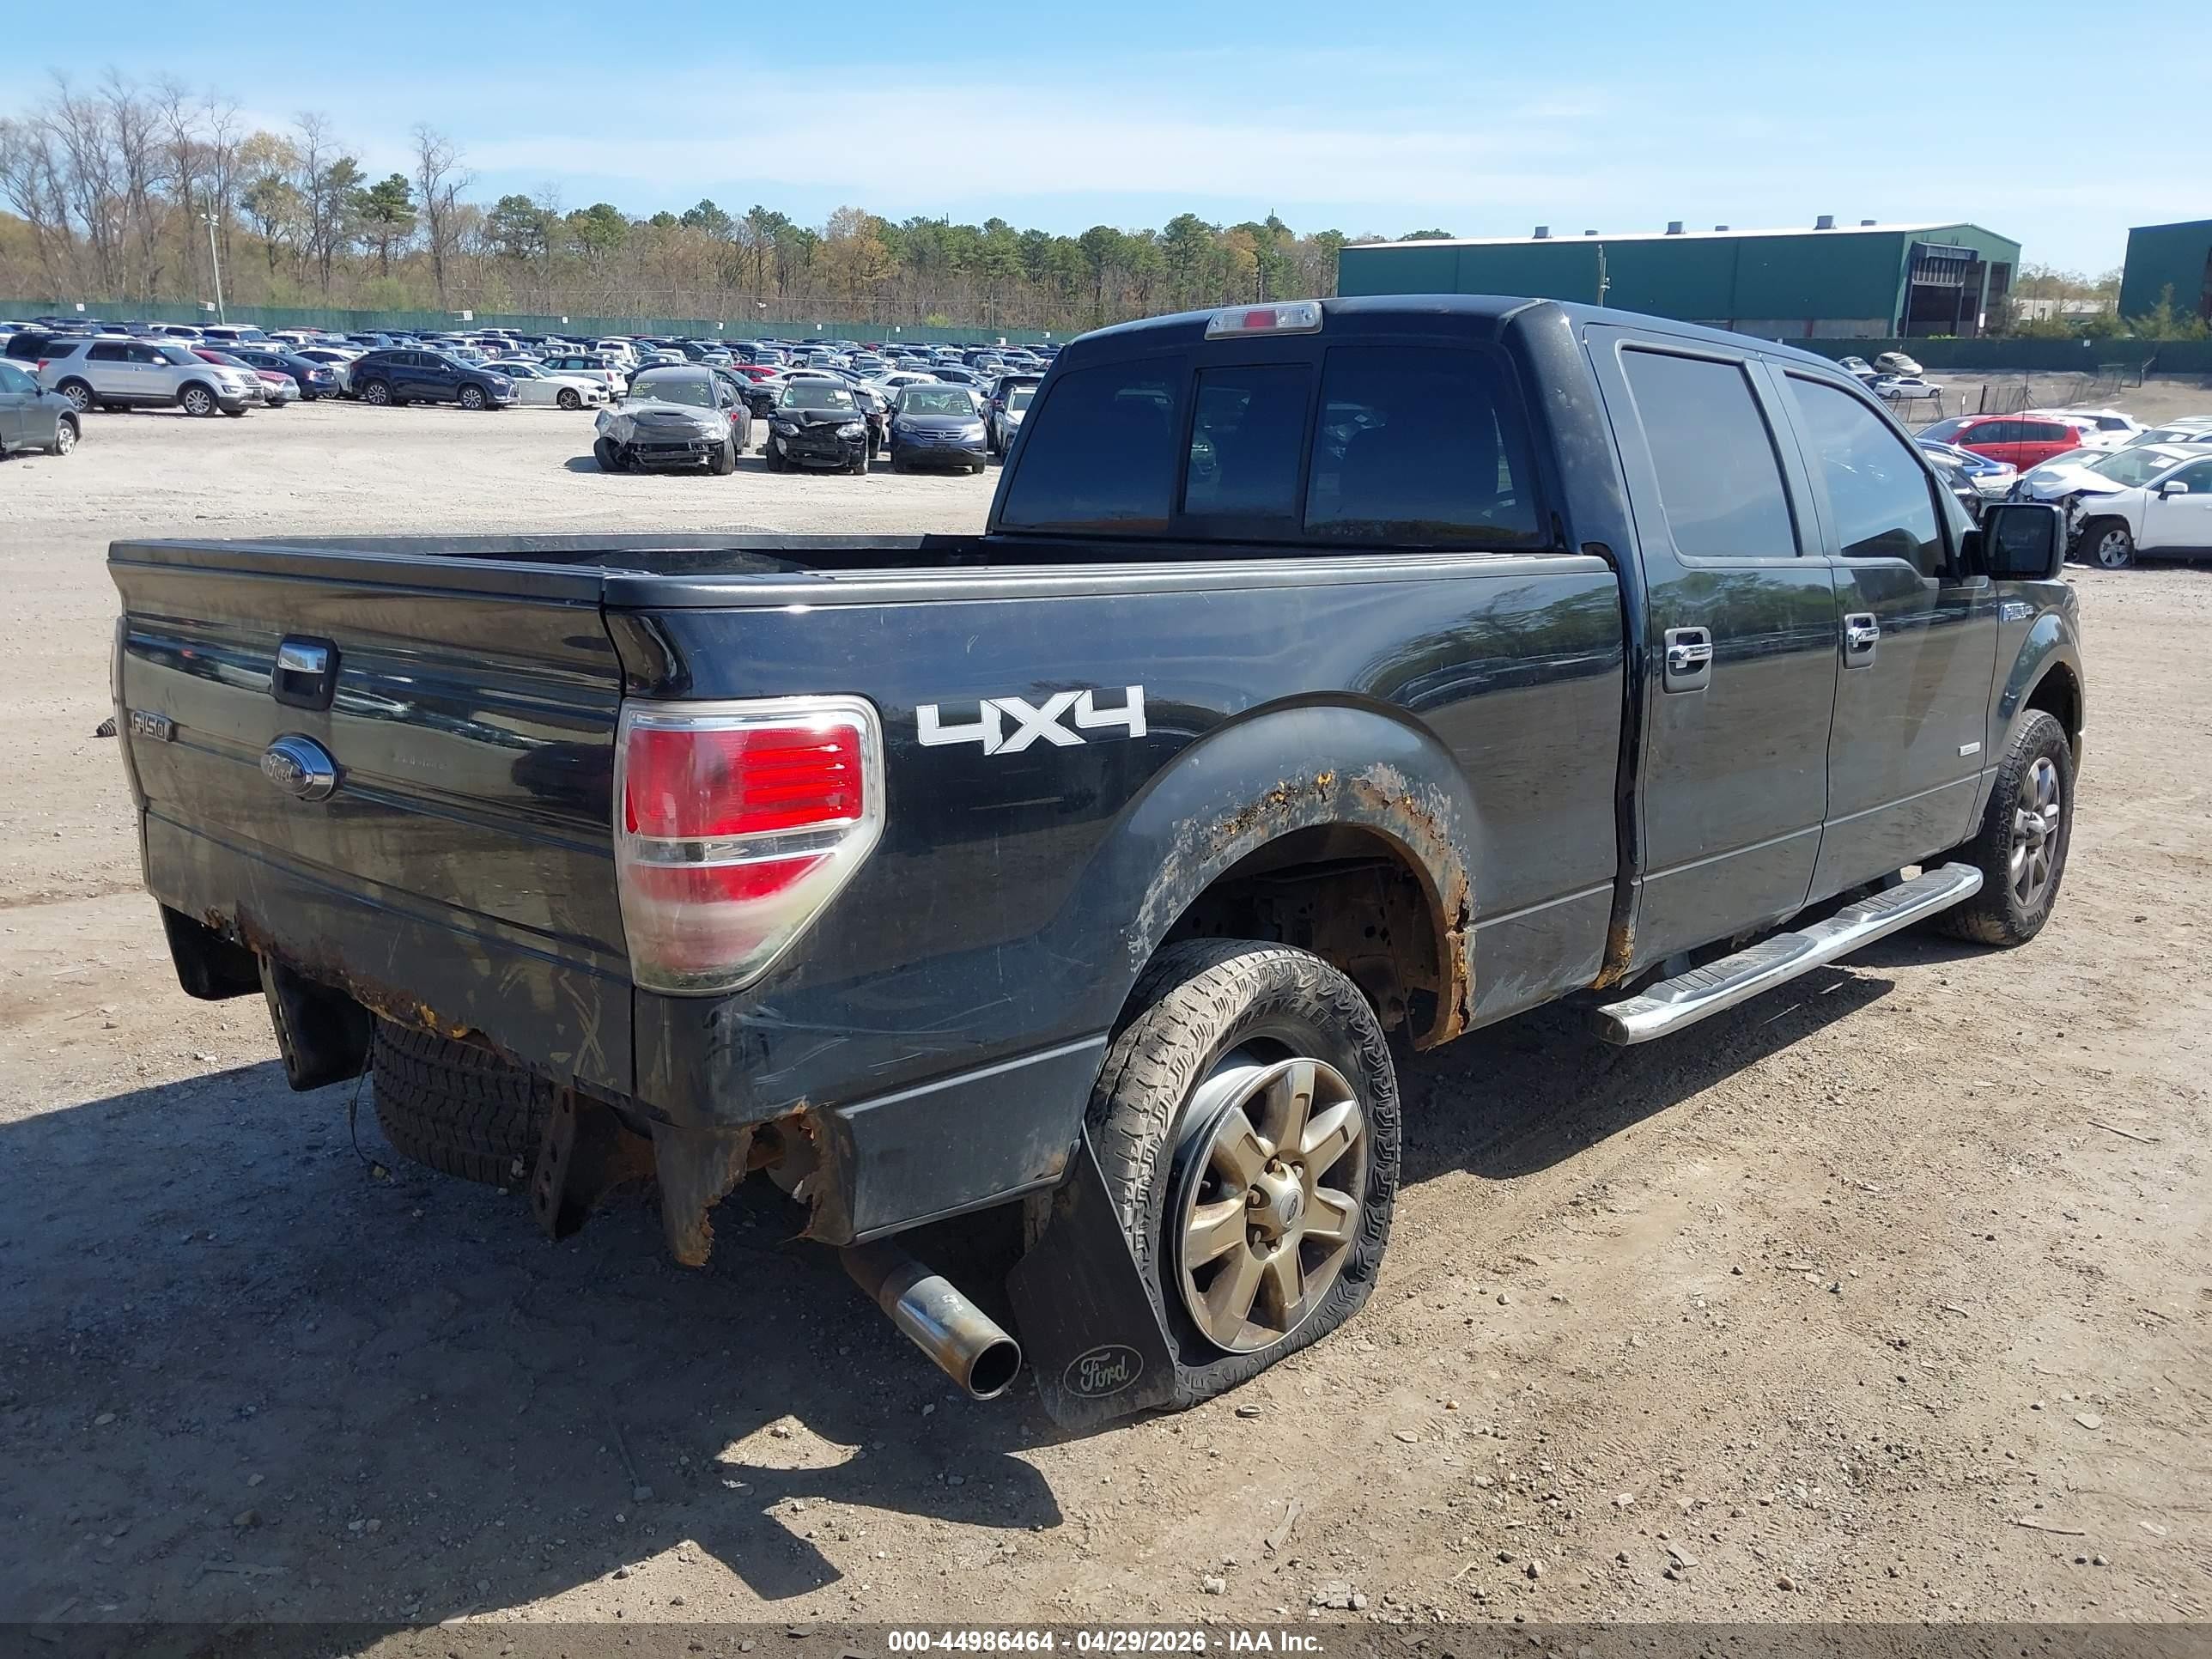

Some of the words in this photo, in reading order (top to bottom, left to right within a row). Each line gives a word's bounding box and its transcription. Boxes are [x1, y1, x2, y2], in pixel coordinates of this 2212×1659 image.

[915, 684, 1147, 756] 4X4
[267, 753, 294, 783] Ford
[1080, 1352, 1130, 1392] Ford
